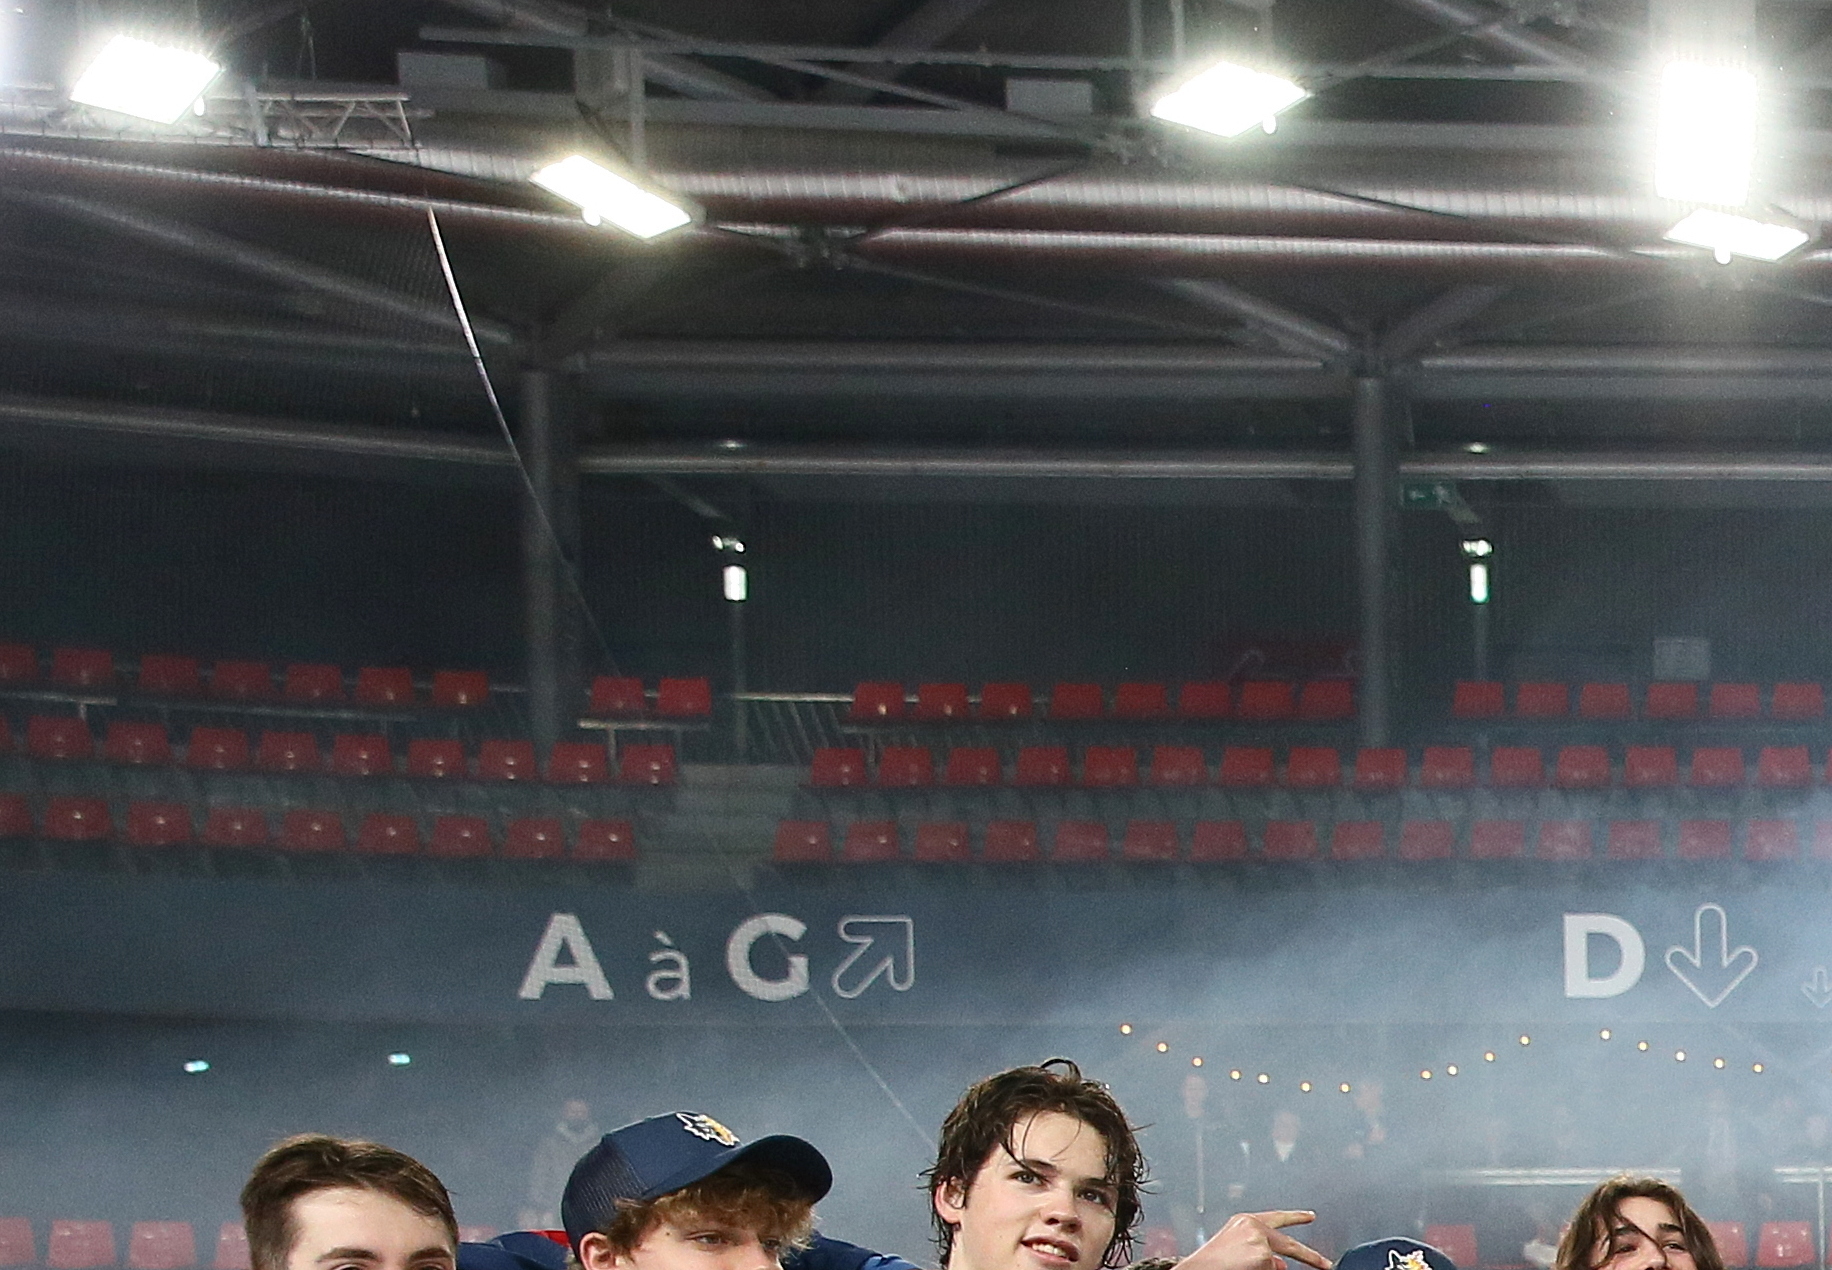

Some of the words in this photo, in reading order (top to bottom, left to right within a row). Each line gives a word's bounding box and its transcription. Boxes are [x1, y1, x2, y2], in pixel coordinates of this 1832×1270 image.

[519, 914, 613, 1000] A
[646, 928, 691, 1000] à
[726, 914, 810, 1000] G
[1564, 913, 1645, 998] D
